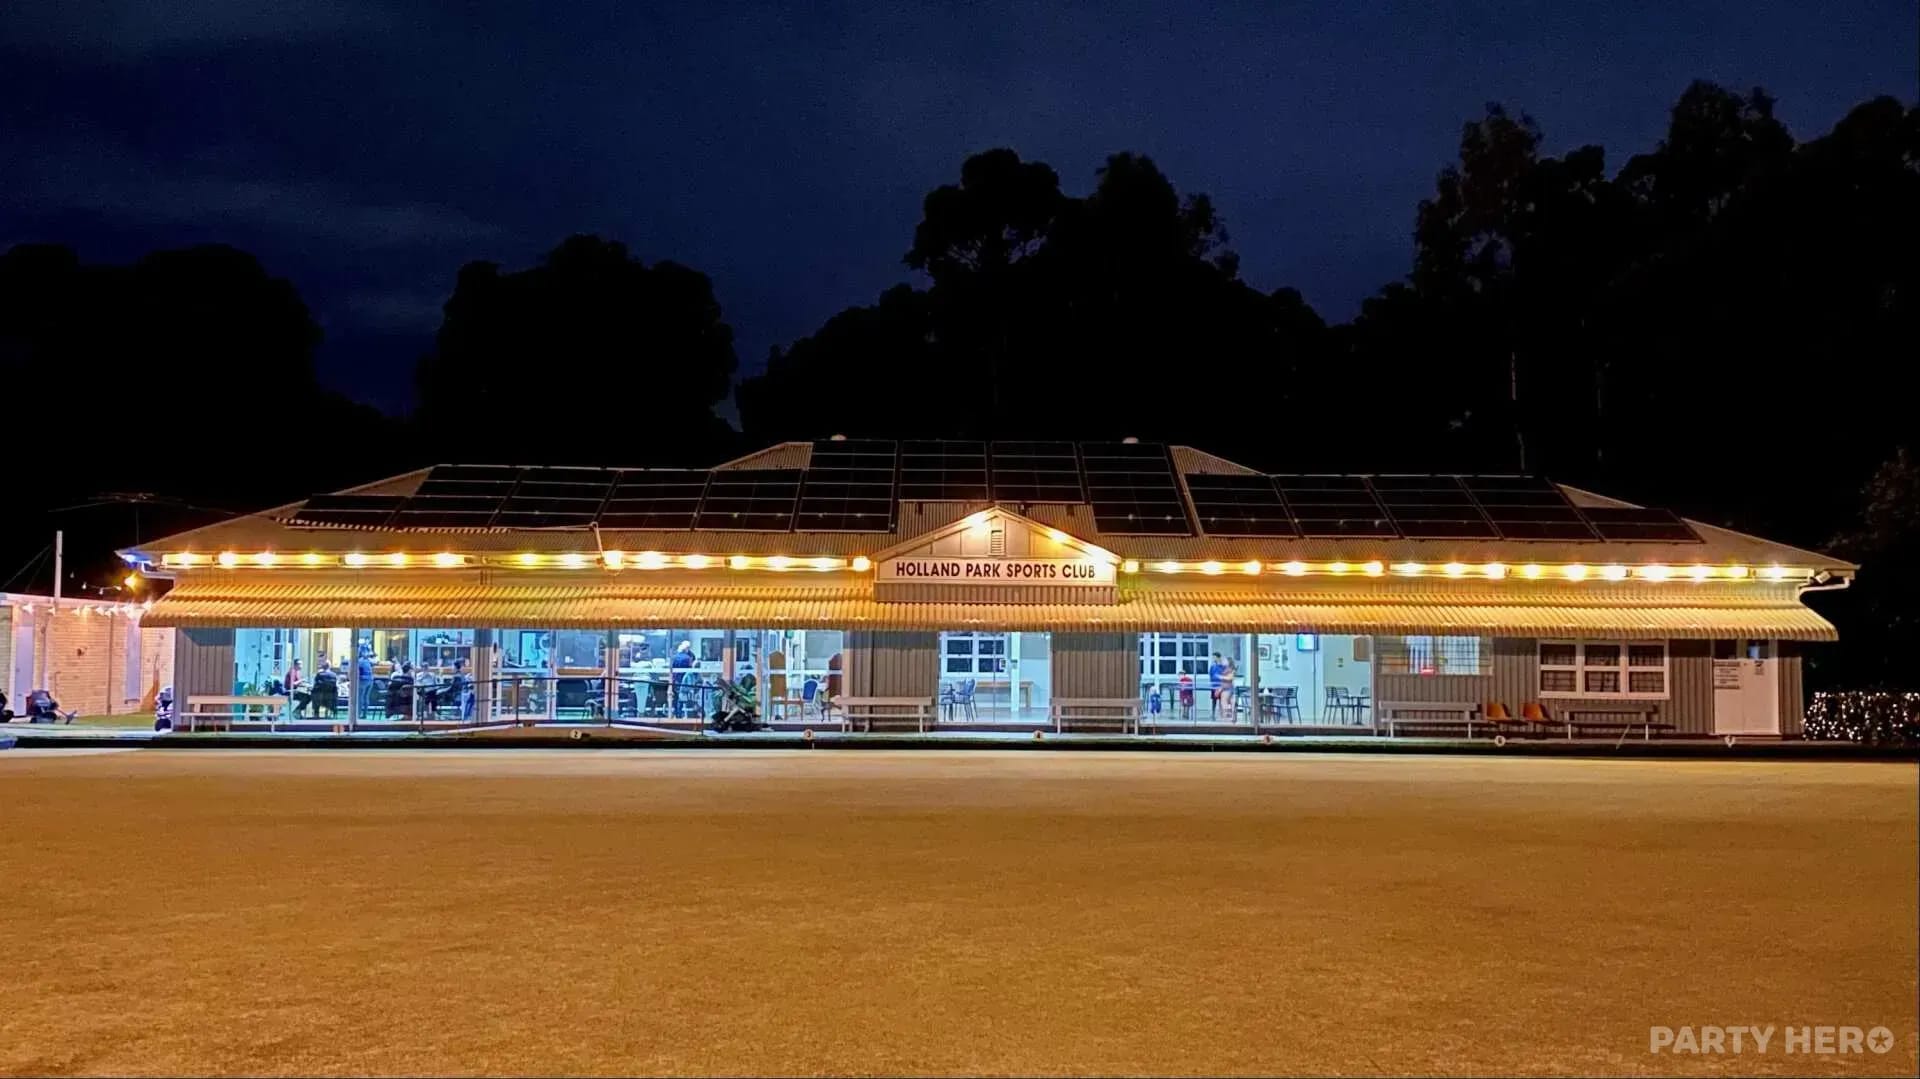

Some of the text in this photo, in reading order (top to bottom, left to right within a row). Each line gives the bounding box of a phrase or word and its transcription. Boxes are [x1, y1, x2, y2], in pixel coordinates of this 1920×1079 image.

[896, 562, 1095, 579] HOLLAND PARK SPORTS CLUB
